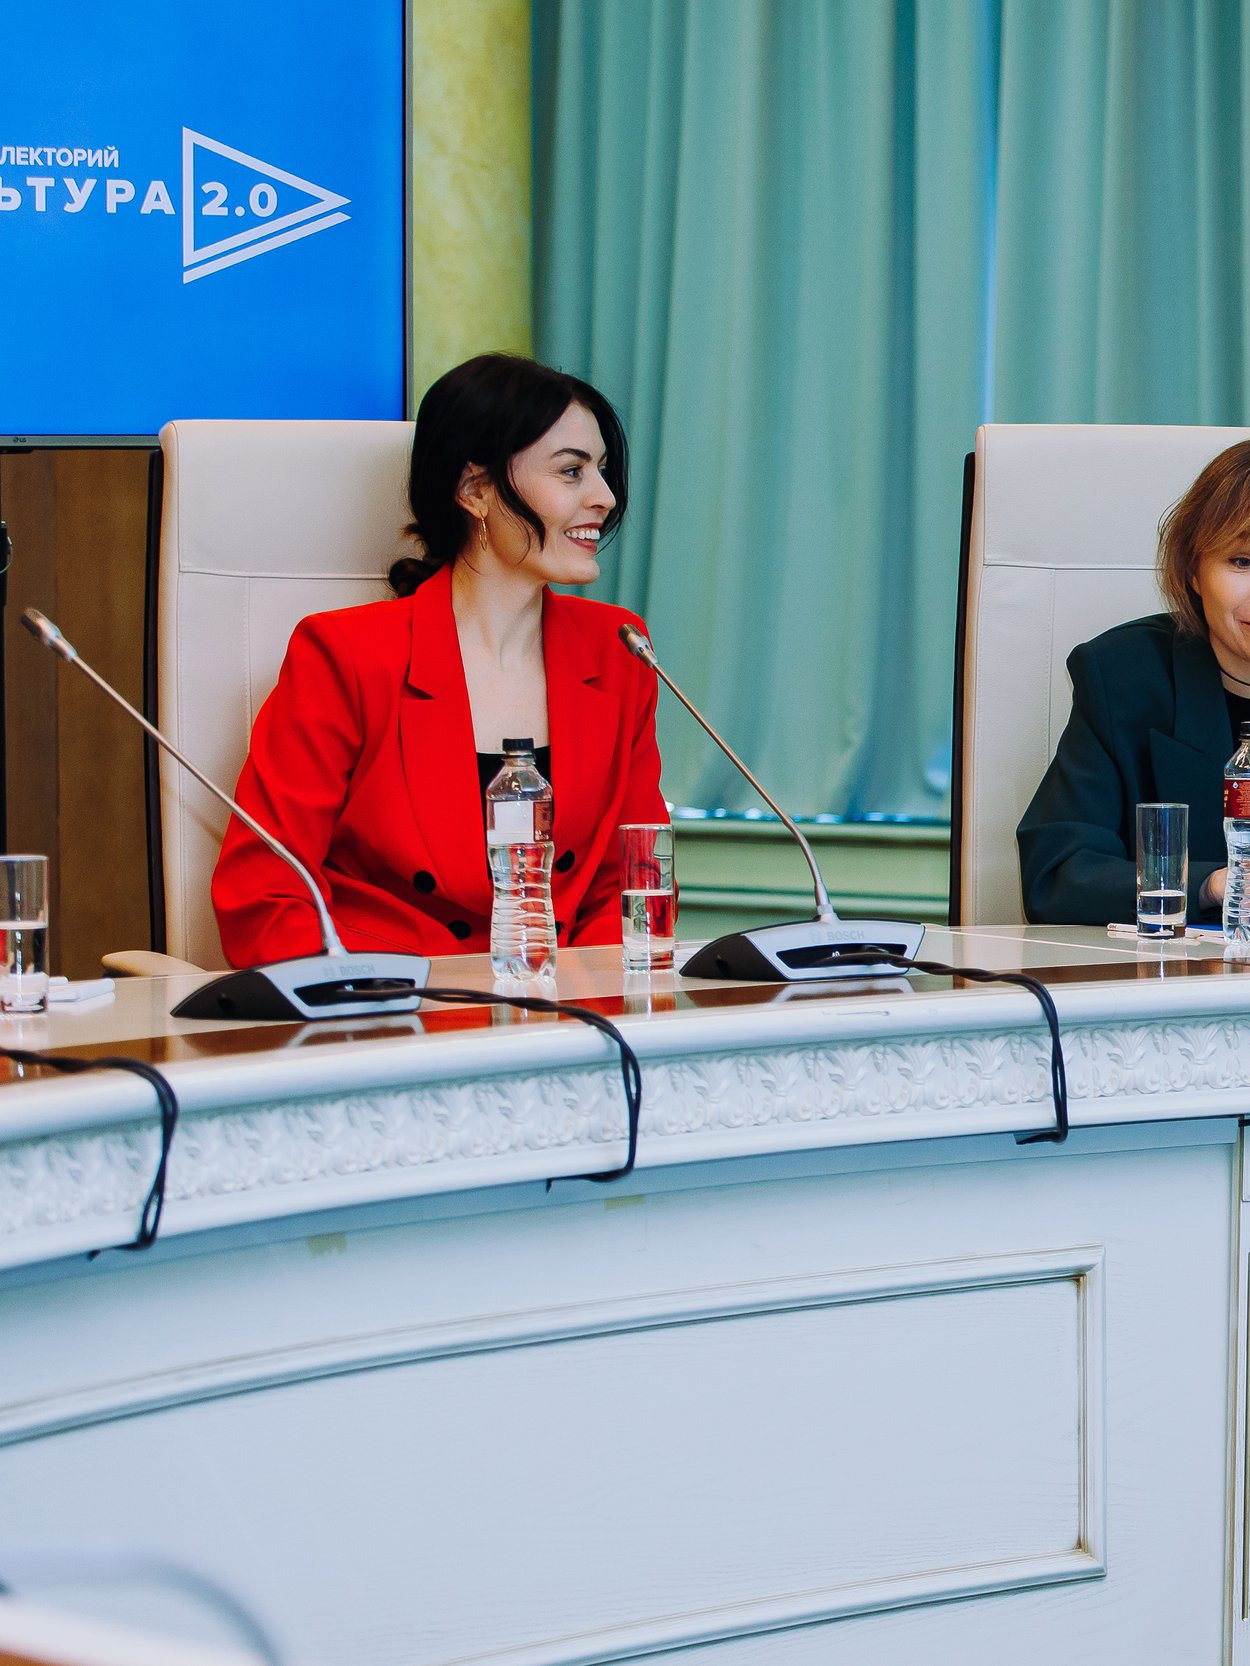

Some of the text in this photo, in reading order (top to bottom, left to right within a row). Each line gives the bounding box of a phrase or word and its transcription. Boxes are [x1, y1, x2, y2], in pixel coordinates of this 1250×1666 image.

[0, 145, 119, 168] ЛЕКТОРИЙ
[201, 181, 278, 217] 2.0
[827, 930, 864, 941] BOSCH
